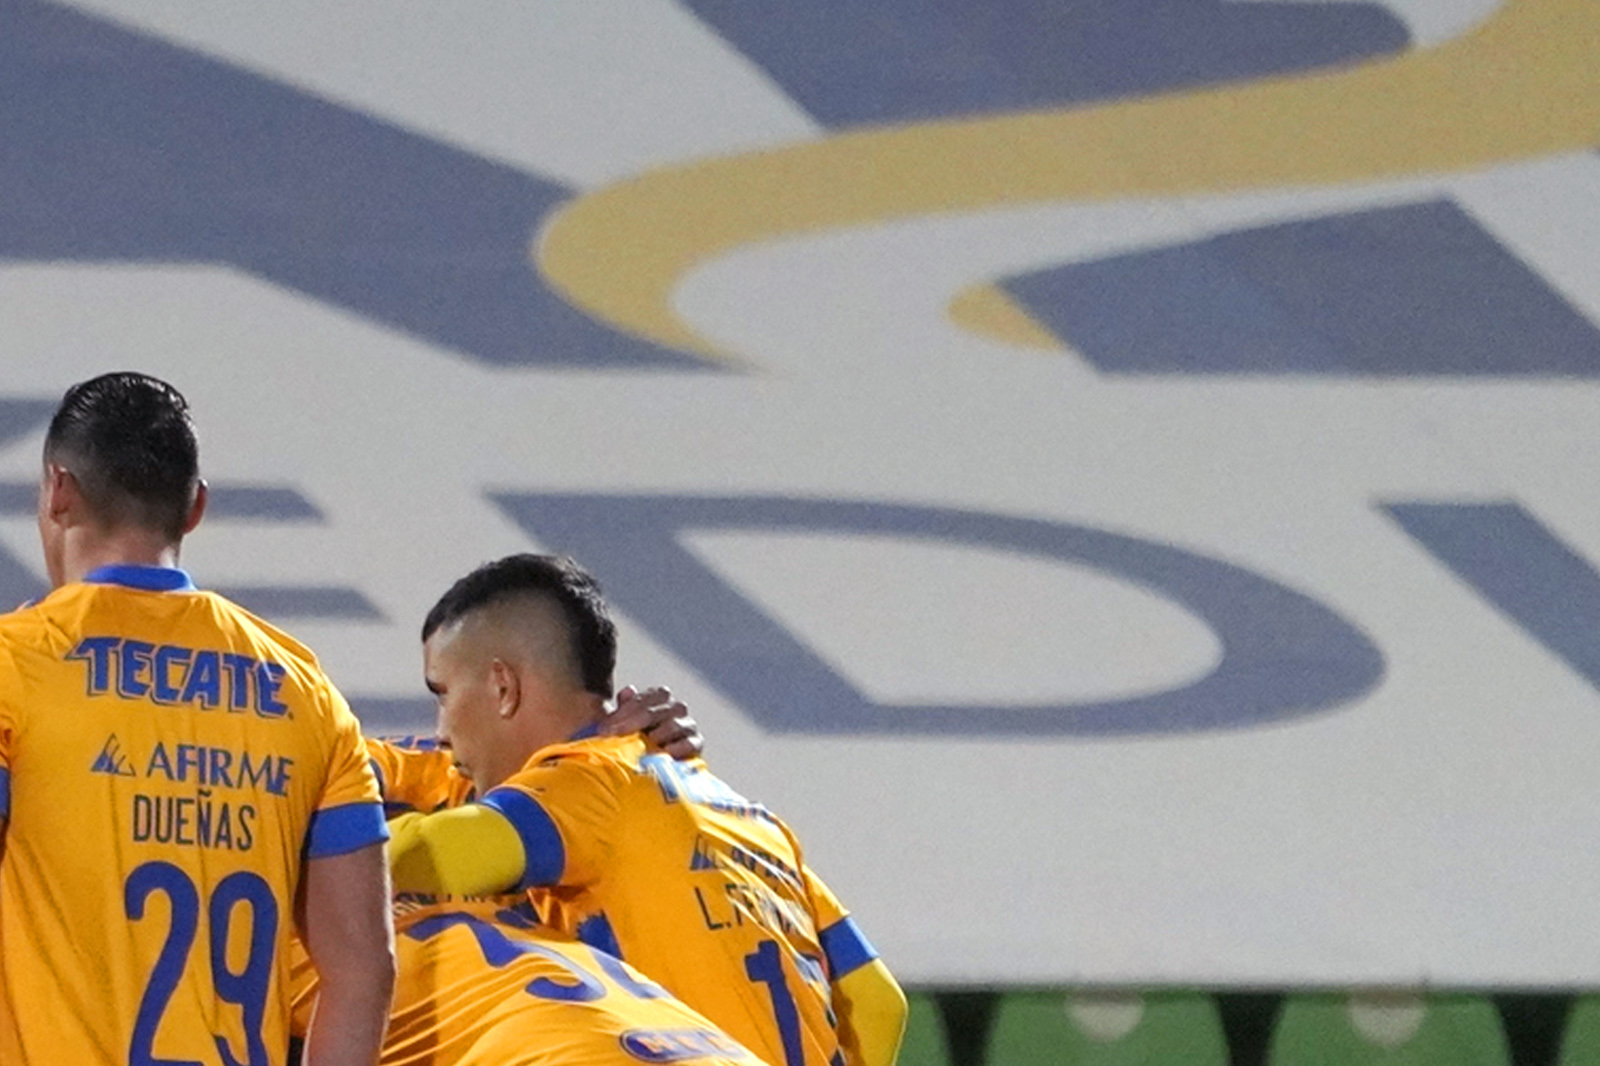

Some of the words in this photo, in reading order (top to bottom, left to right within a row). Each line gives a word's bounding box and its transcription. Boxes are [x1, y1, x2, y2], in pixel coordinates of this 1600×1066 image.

[65, 635, 293, 720] TECATE
[147, 741, 294, 797] AFIRME
[133, 789, 255, 851] DUEÑAS
